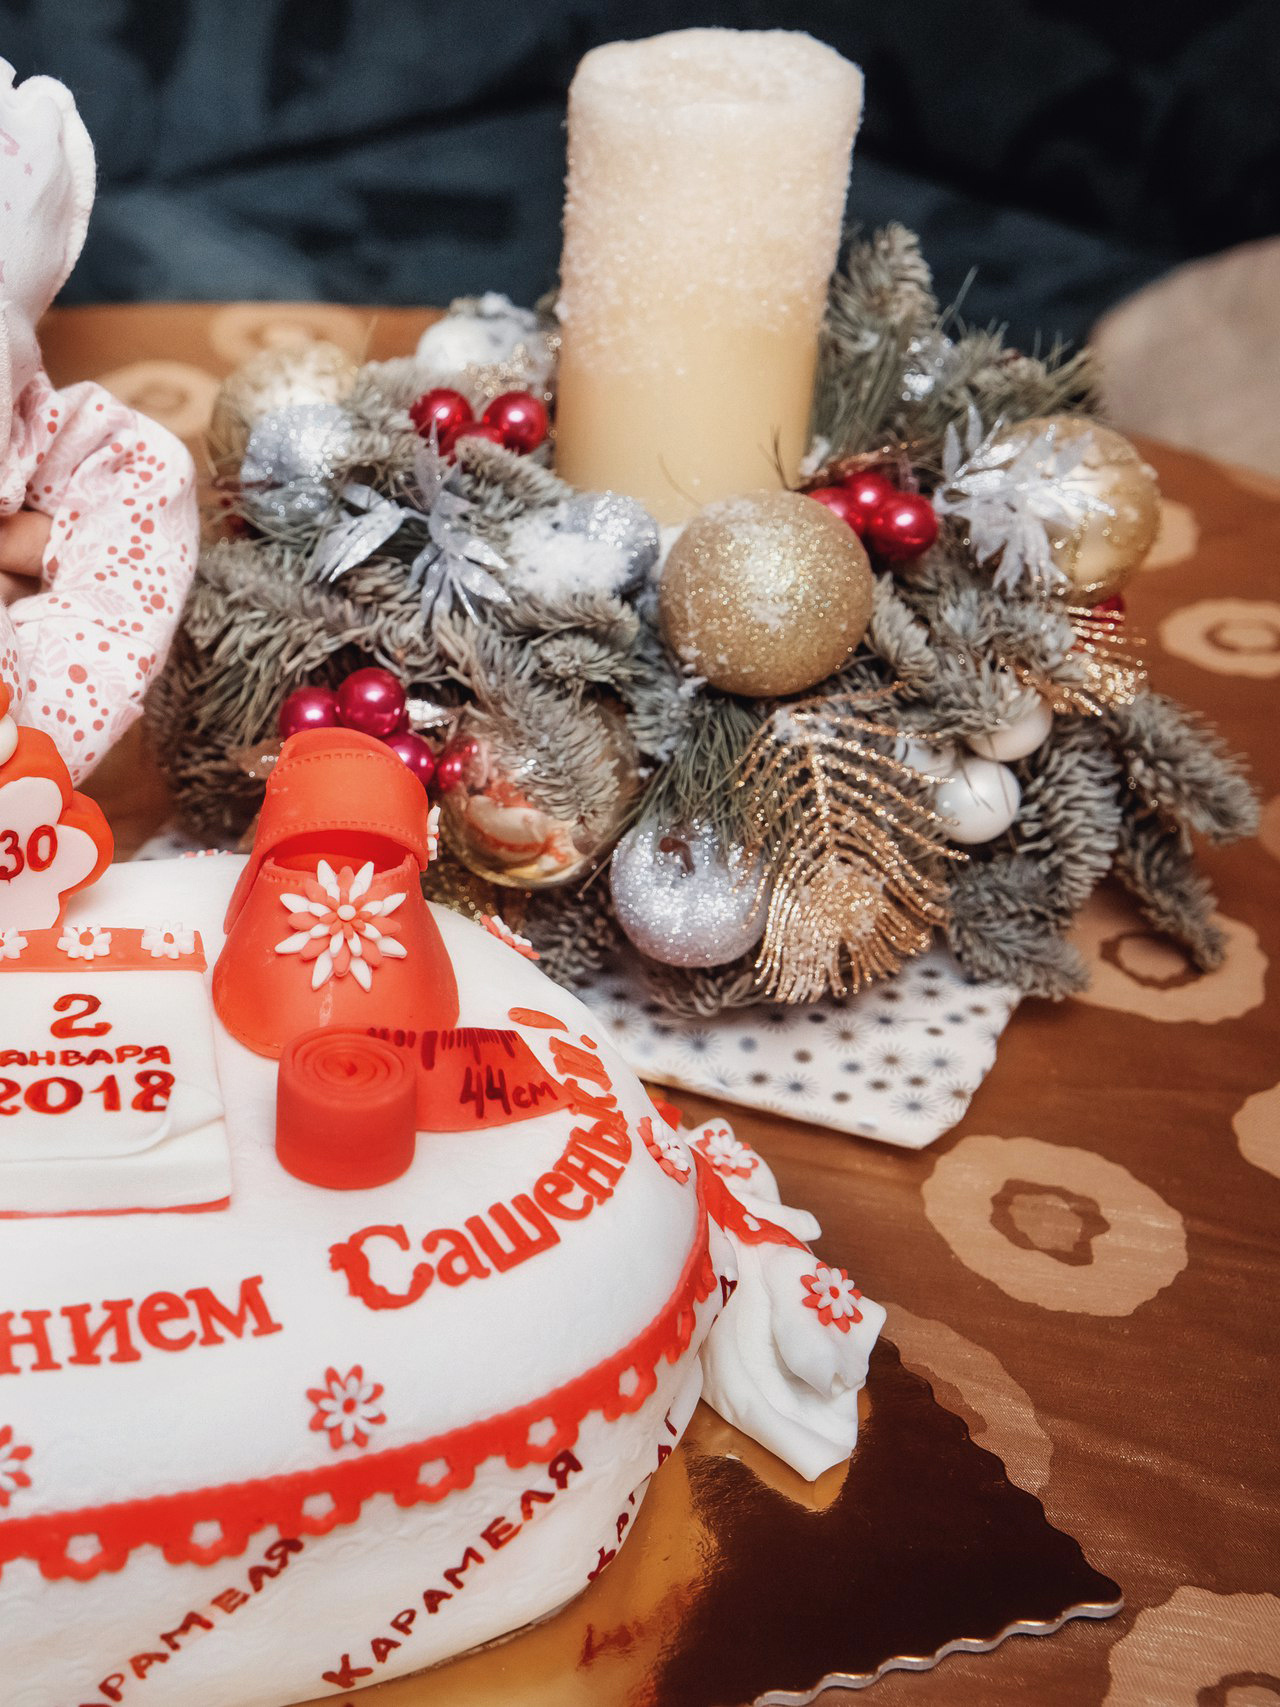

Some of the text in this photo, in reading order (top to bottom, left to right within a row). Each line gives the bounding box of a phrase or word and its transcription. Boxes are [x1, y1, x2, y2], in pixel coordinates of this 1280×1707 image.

[50, 993, 112, 1039] 2
[77, 1538, 304, 1707] РАМЕЛЯ
[321, 1449, 583, 1689] КАРАМЕЛЯ
